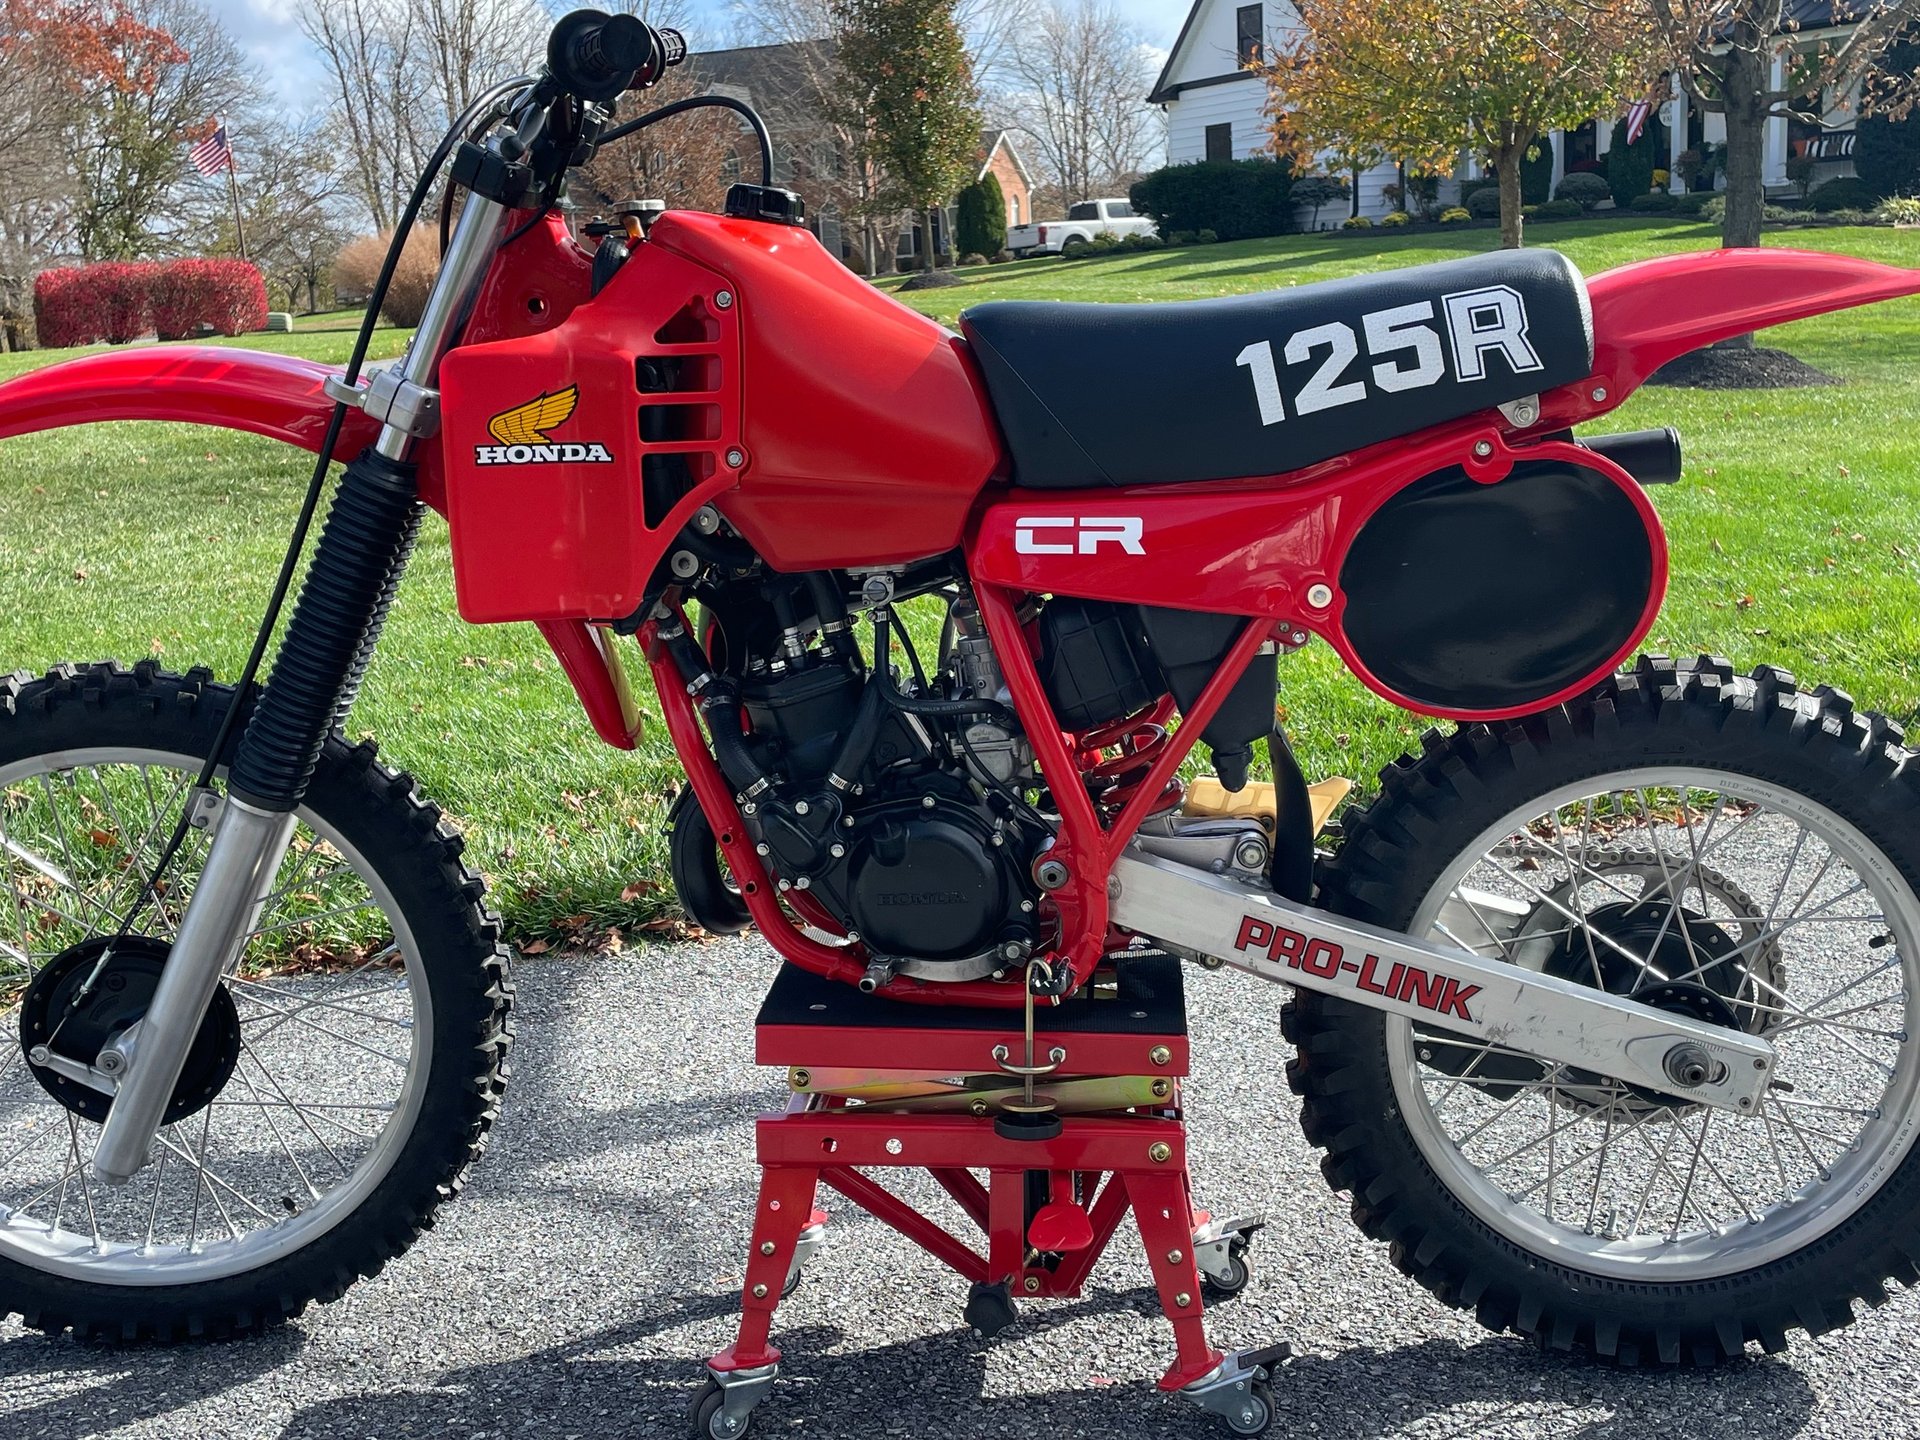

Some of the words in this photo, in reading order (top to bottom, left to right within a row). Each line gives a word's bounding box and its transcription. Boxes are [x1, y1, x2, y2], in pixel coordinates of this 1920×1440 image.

[1235, 284, 1545, 426] 125R
[476, 443, 613, 465] HONDA
[1015, 517, 1147, 555] CR
[1743, 786, 1772, 798] JAPAN
[877, 892, 968, 906] HONDA
[1234, 915, 1483, 1023] PRO-LINK
